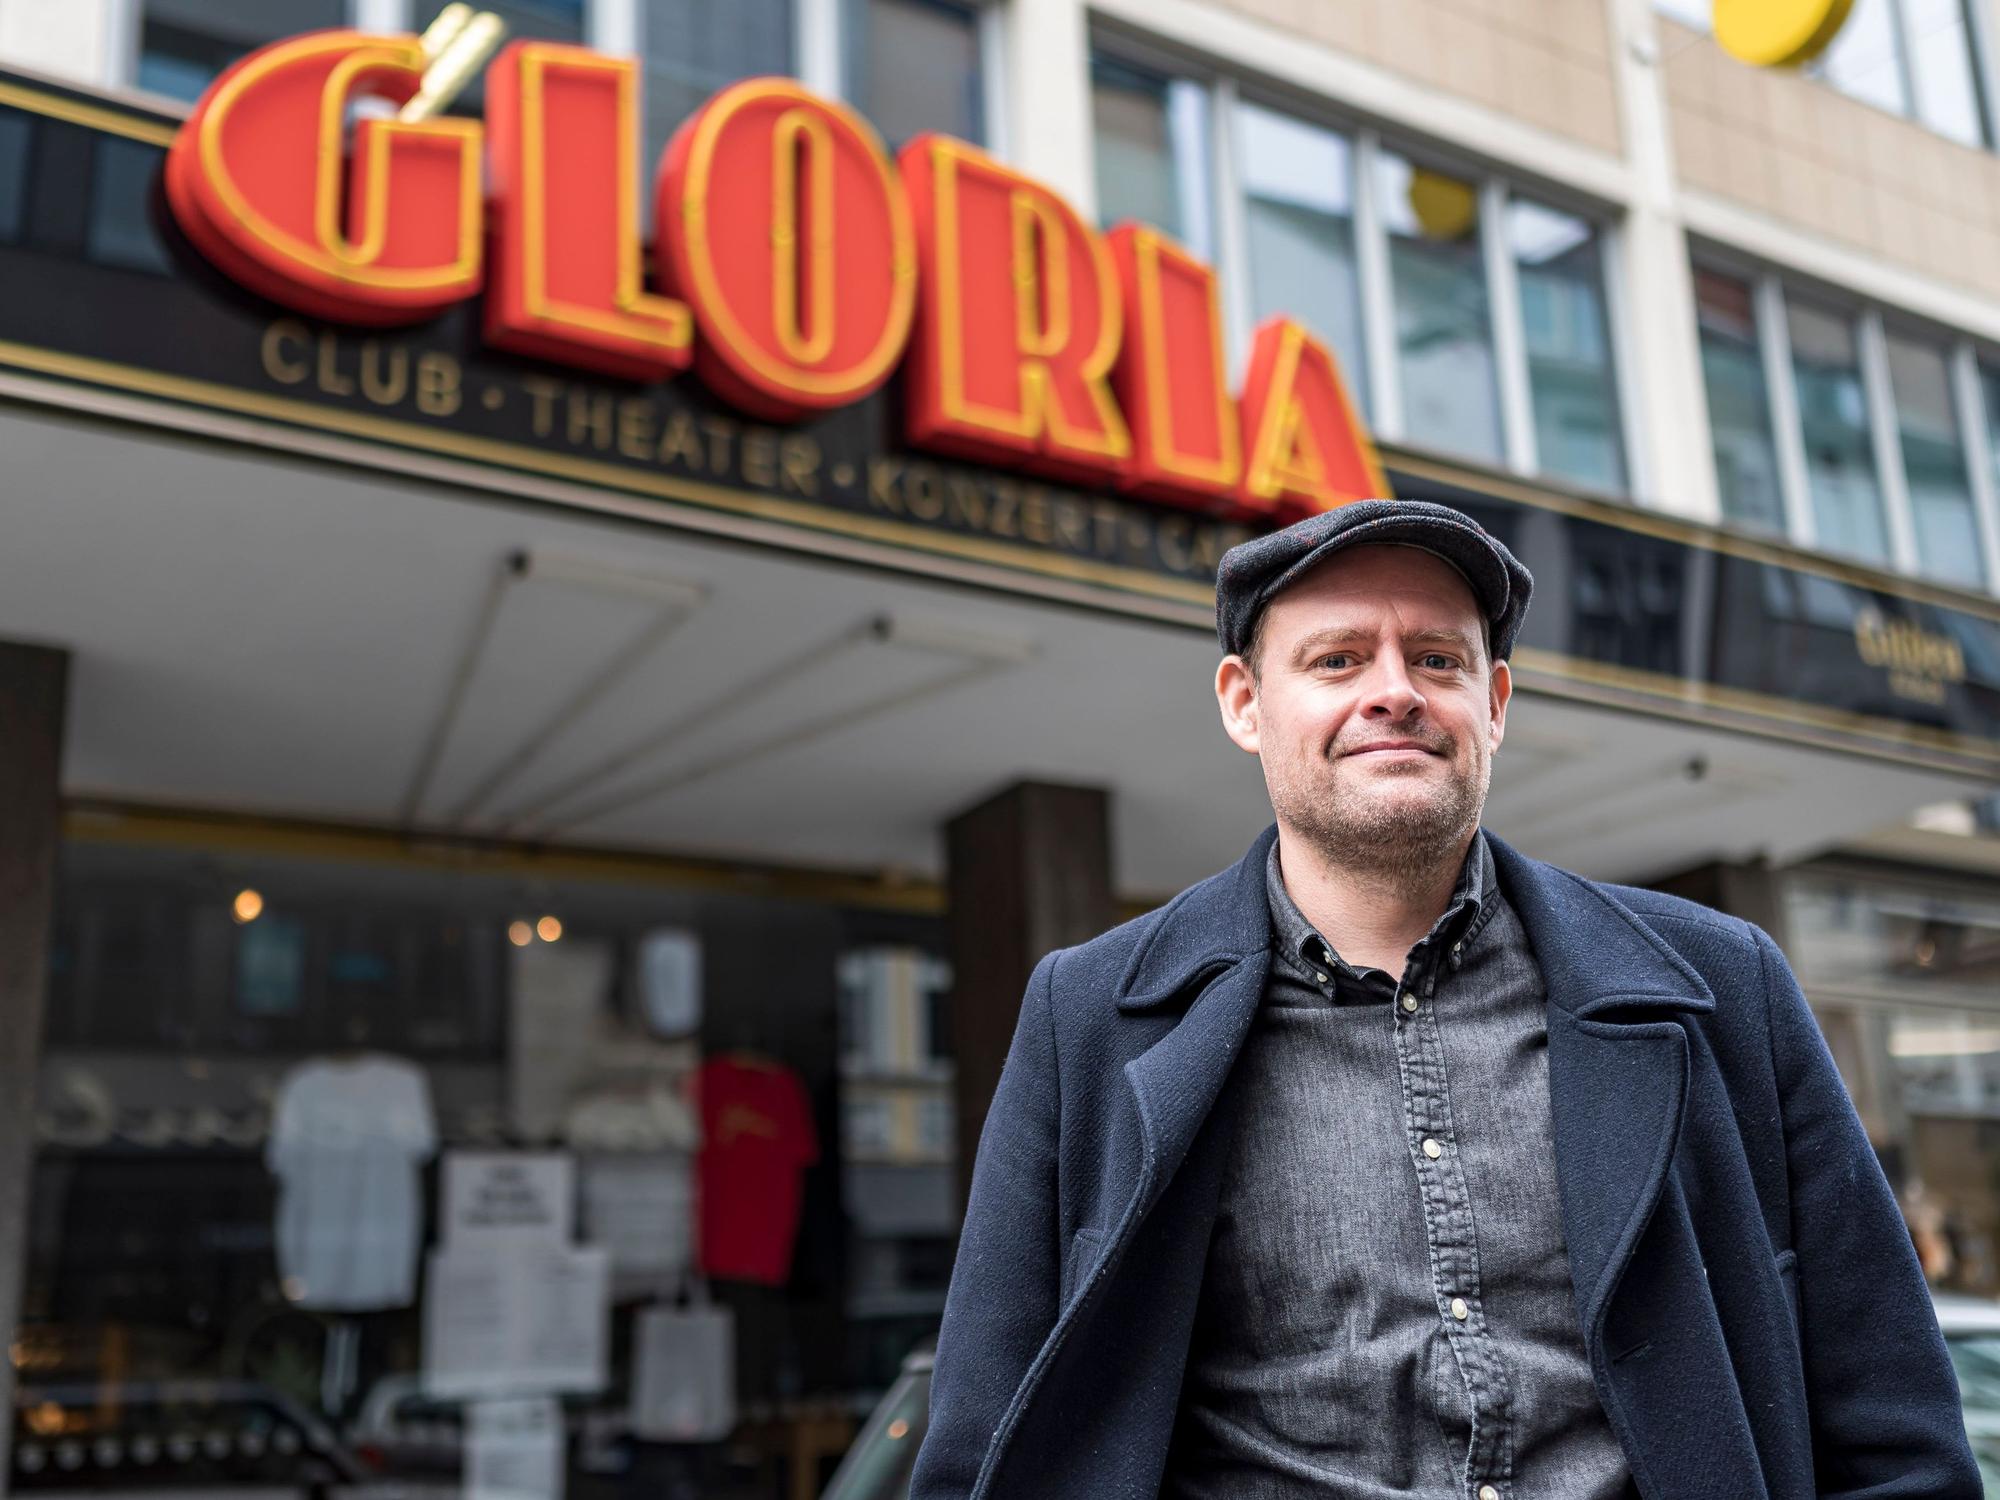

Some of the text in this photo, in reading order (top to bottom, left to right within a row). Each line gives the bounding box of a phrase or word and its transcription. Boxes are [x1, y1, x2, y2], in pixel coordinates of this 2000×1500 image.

[166, 27, 1394, 525] GLORIA
[260, 317, 462, 417] CLUB
[524, 373, 822, 497] THEATER
[867, 455, 1120, 552] KONZERT
